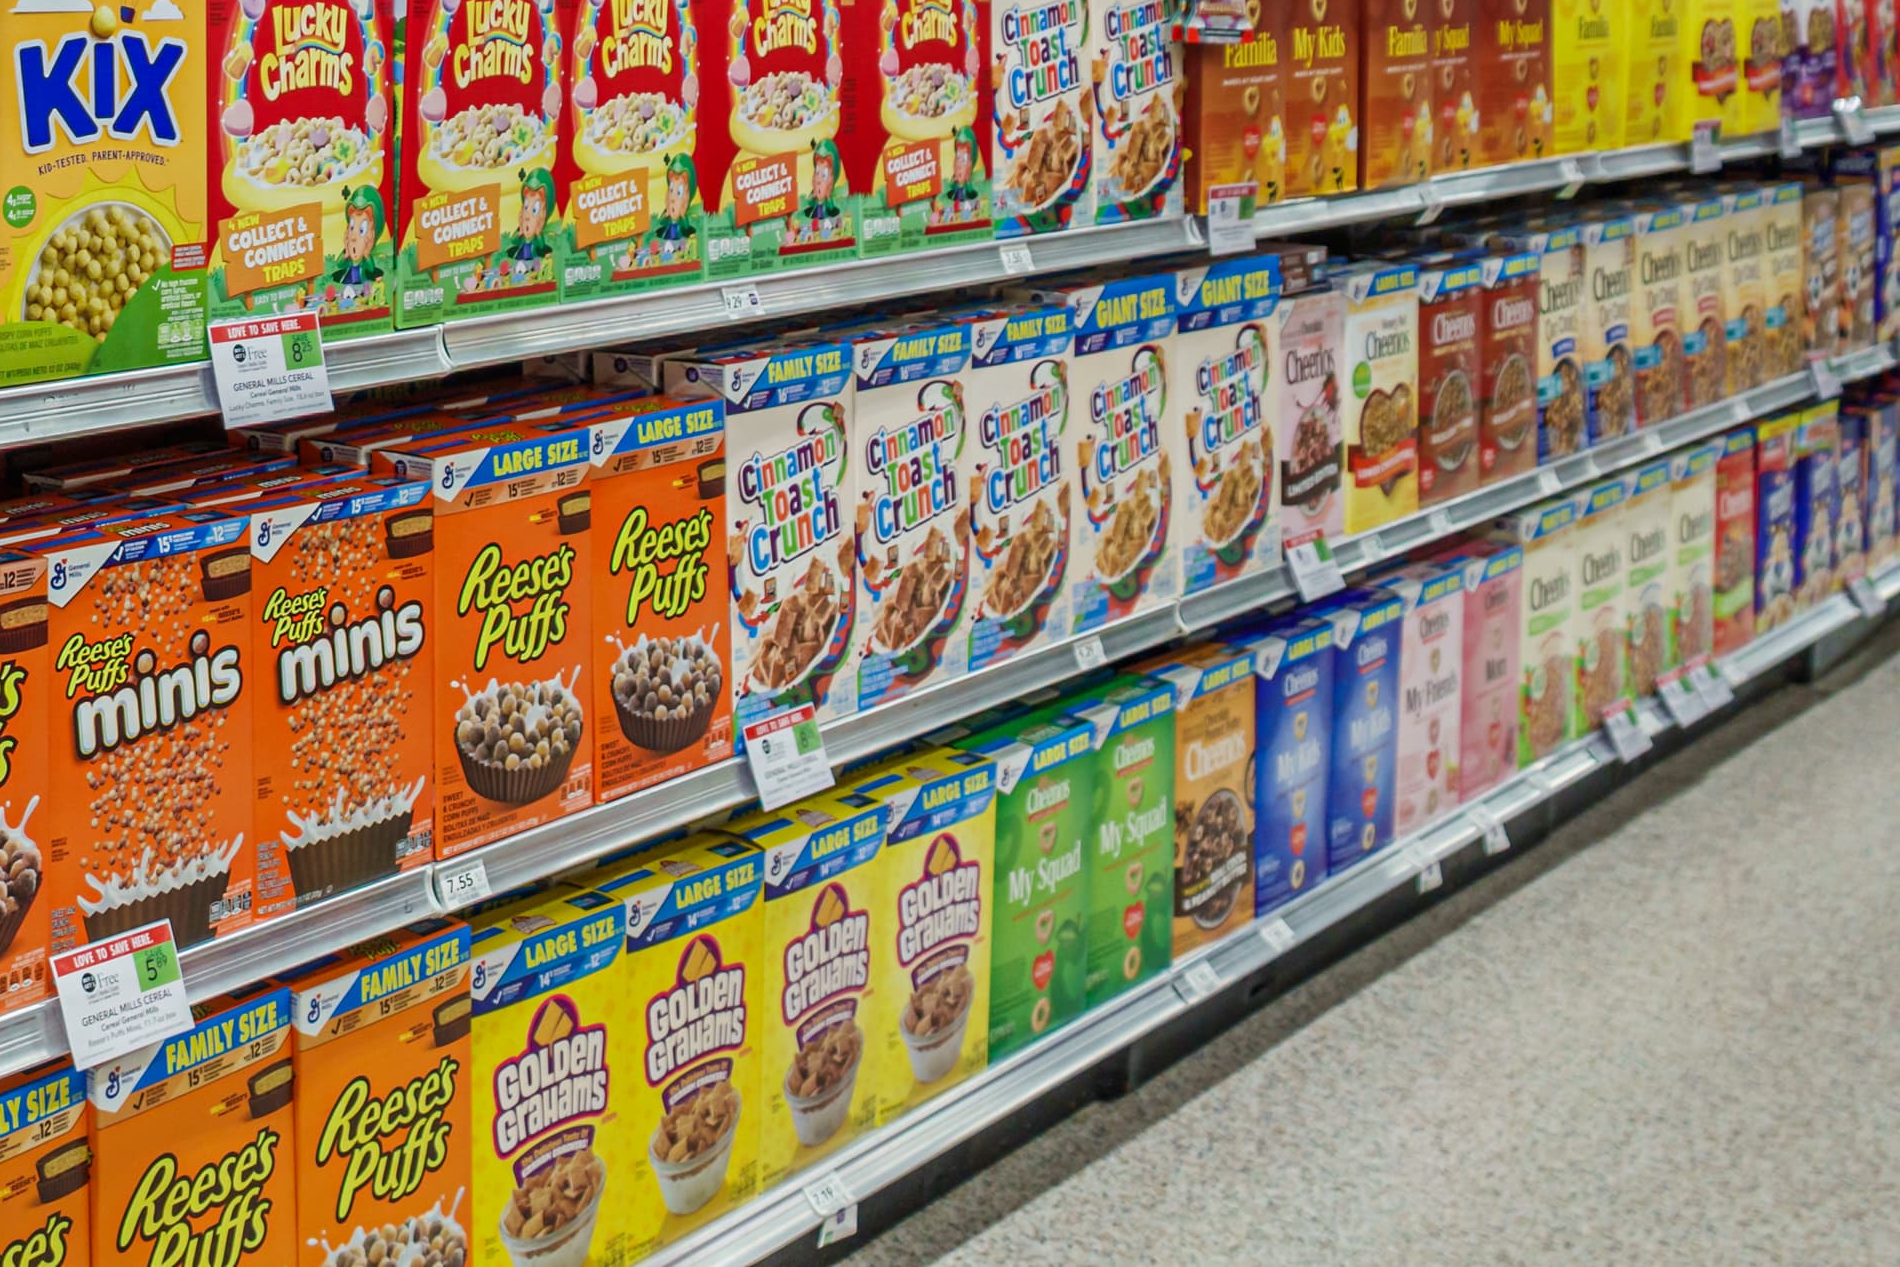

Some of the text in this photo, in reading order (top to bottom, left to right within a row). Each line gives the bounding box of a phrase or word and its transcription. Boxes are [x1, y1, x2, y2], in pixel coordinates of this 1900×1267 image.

[1294, 26, 1346, 68] My Kids
[260, 44, 353, 102] Charms
[228, 216, 309, 251] COLLECT &
[244, 235, 316, 269] CONNECT
[262, 259, 307, 284] TRAPS
[1286, 347, 1335, 385] Cheerios
[1366, 331, 1410, 361] Cheerios
[767, 351, 843, 387] FAMILY SIZE
[493, 438, 579, 479] LARGE SIZE
[737, 433, 839, 506] Cinnamon
[762, 472, 823, 527] Toast
[749, 503, 841, 579] Crunch
[75, 630, 242, 759] minis
[446, 872, 473, 893] 7.55
[1008, 840, 1082, 907] My Squad
[525, 918, 615, 971] LARGE SIZE
[35, 1074, 71, 1121] SIZE
